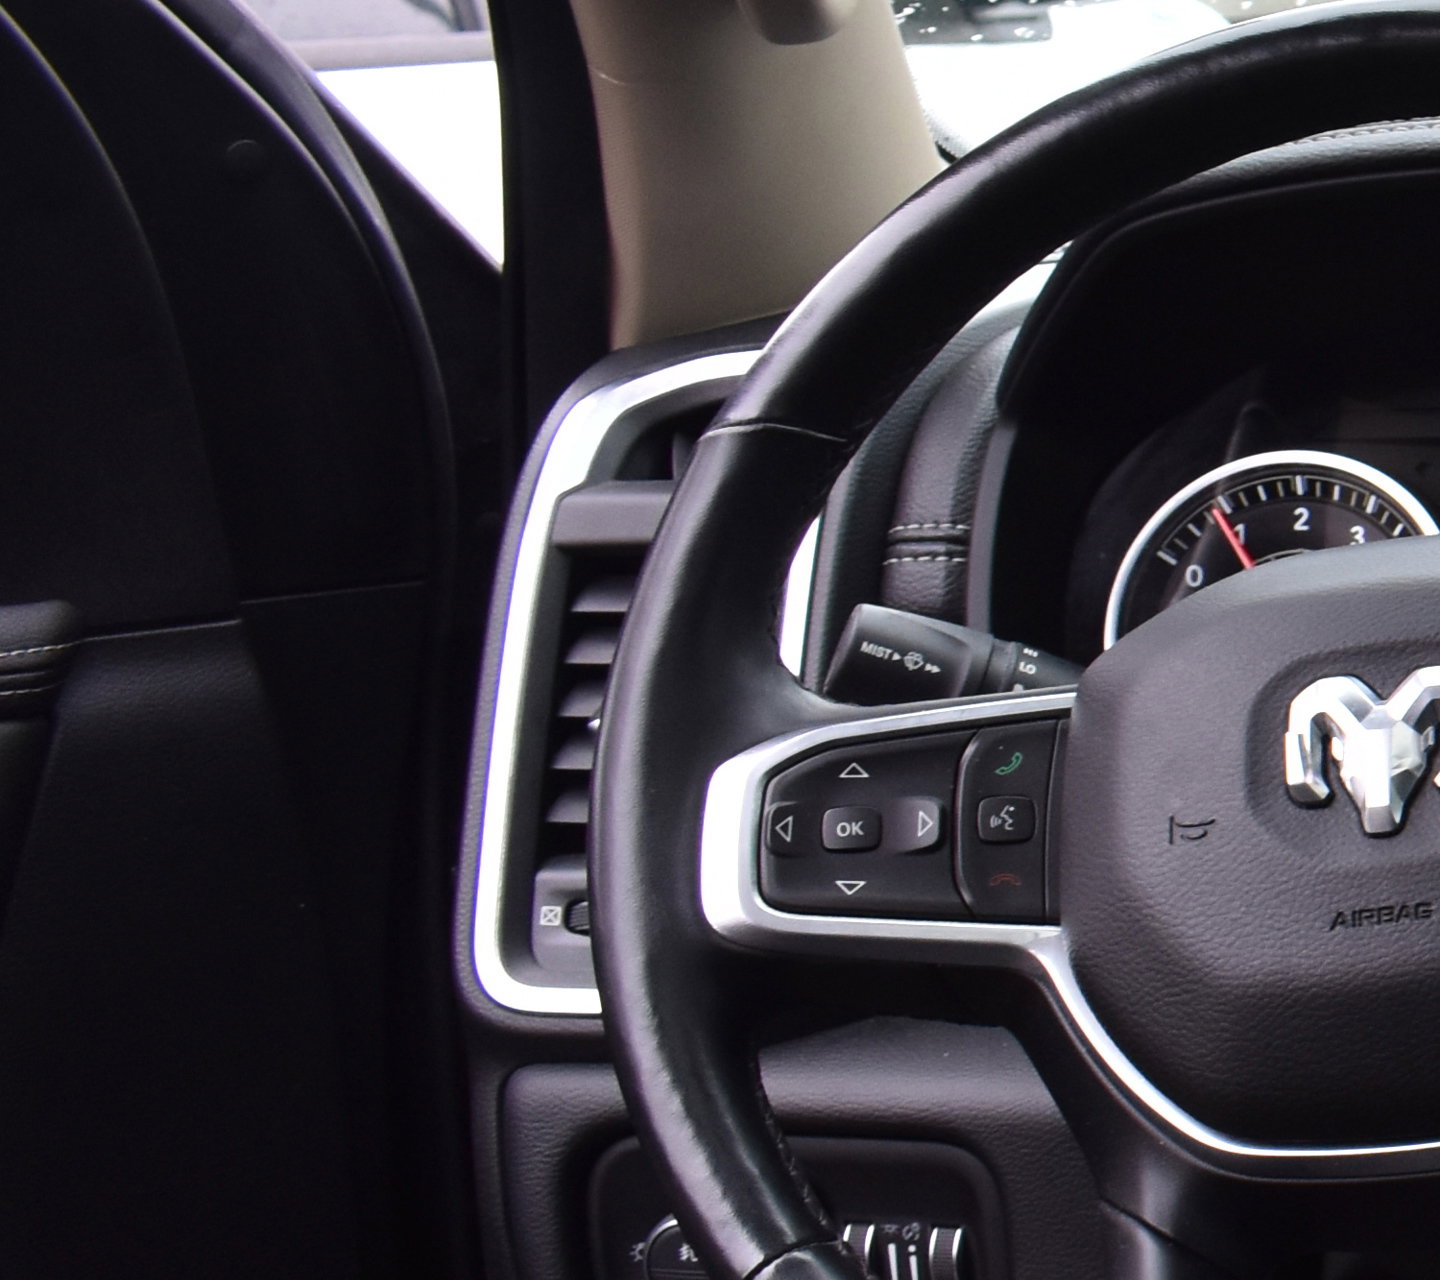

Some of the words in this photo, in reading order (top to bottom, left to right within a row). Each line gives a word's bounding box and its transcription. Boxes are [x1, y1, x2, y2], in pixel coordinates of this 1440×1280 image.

[1292, 507, 1310, 532] 2
[1349, 526, 1365, 547] 3
[1185, 565, 1203, 588] 0
[860, 640, 892, 660] MIST
[836, 821, 864, 836] OK
[1329, 902, 1434, 932] AIRBAG
